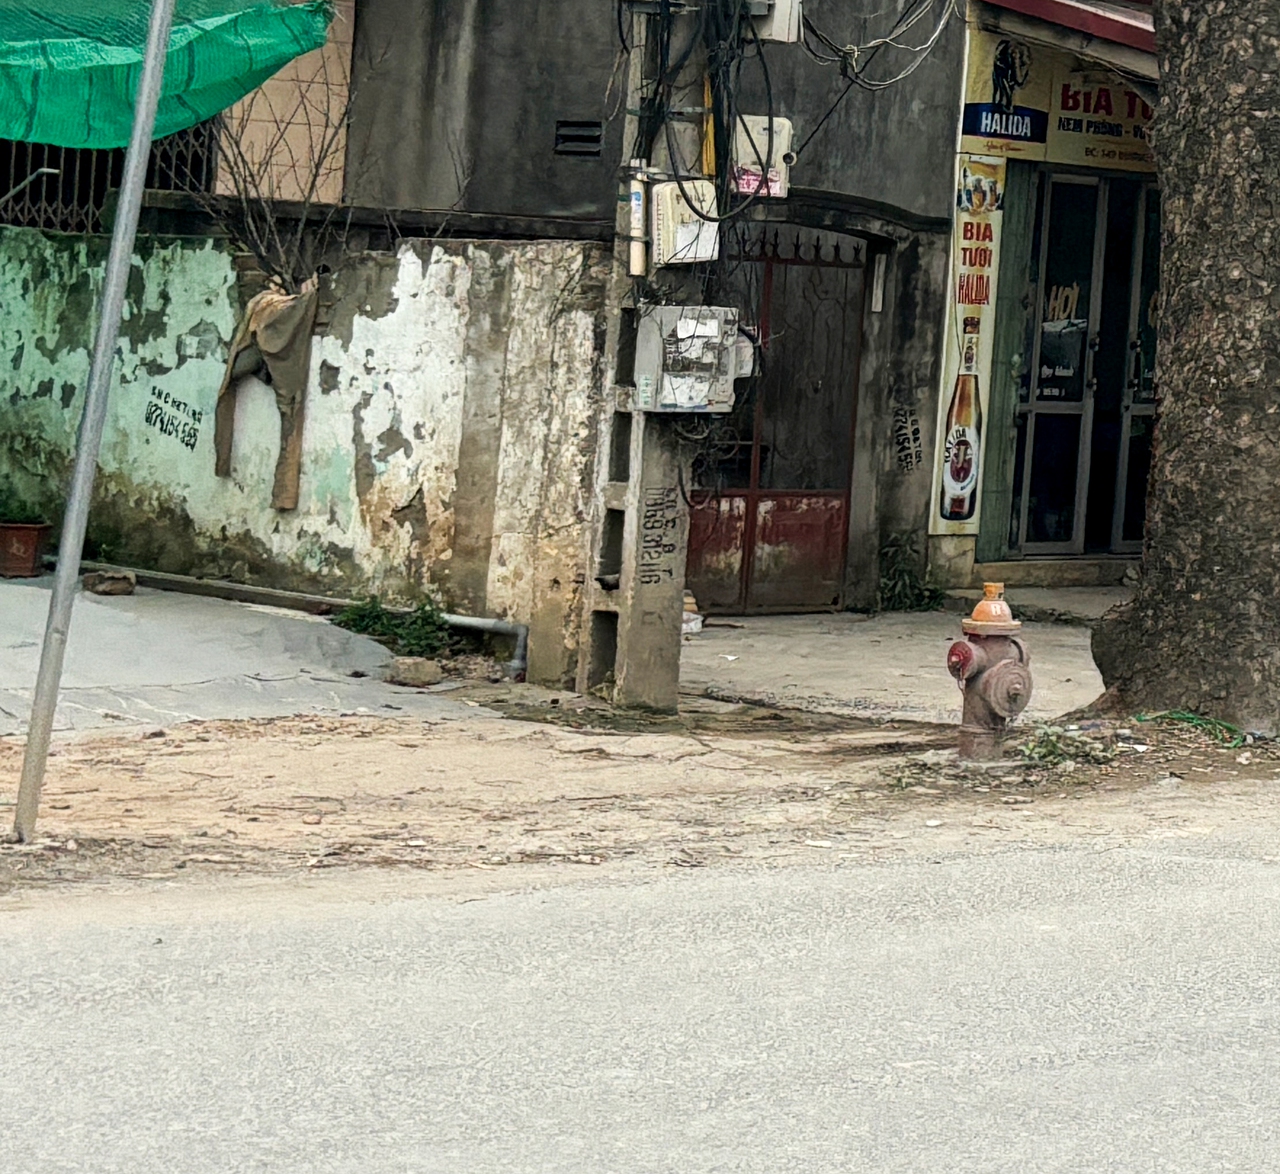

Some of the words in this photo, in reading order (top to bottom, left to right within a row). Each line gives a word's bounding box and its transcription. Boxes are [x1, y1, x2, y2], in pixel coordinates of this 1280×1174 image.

[980, 111, 1031, 138] HALIDA
[963, 222, 993, 242] BIA
[958, 273, 990, 305] HALIDA
